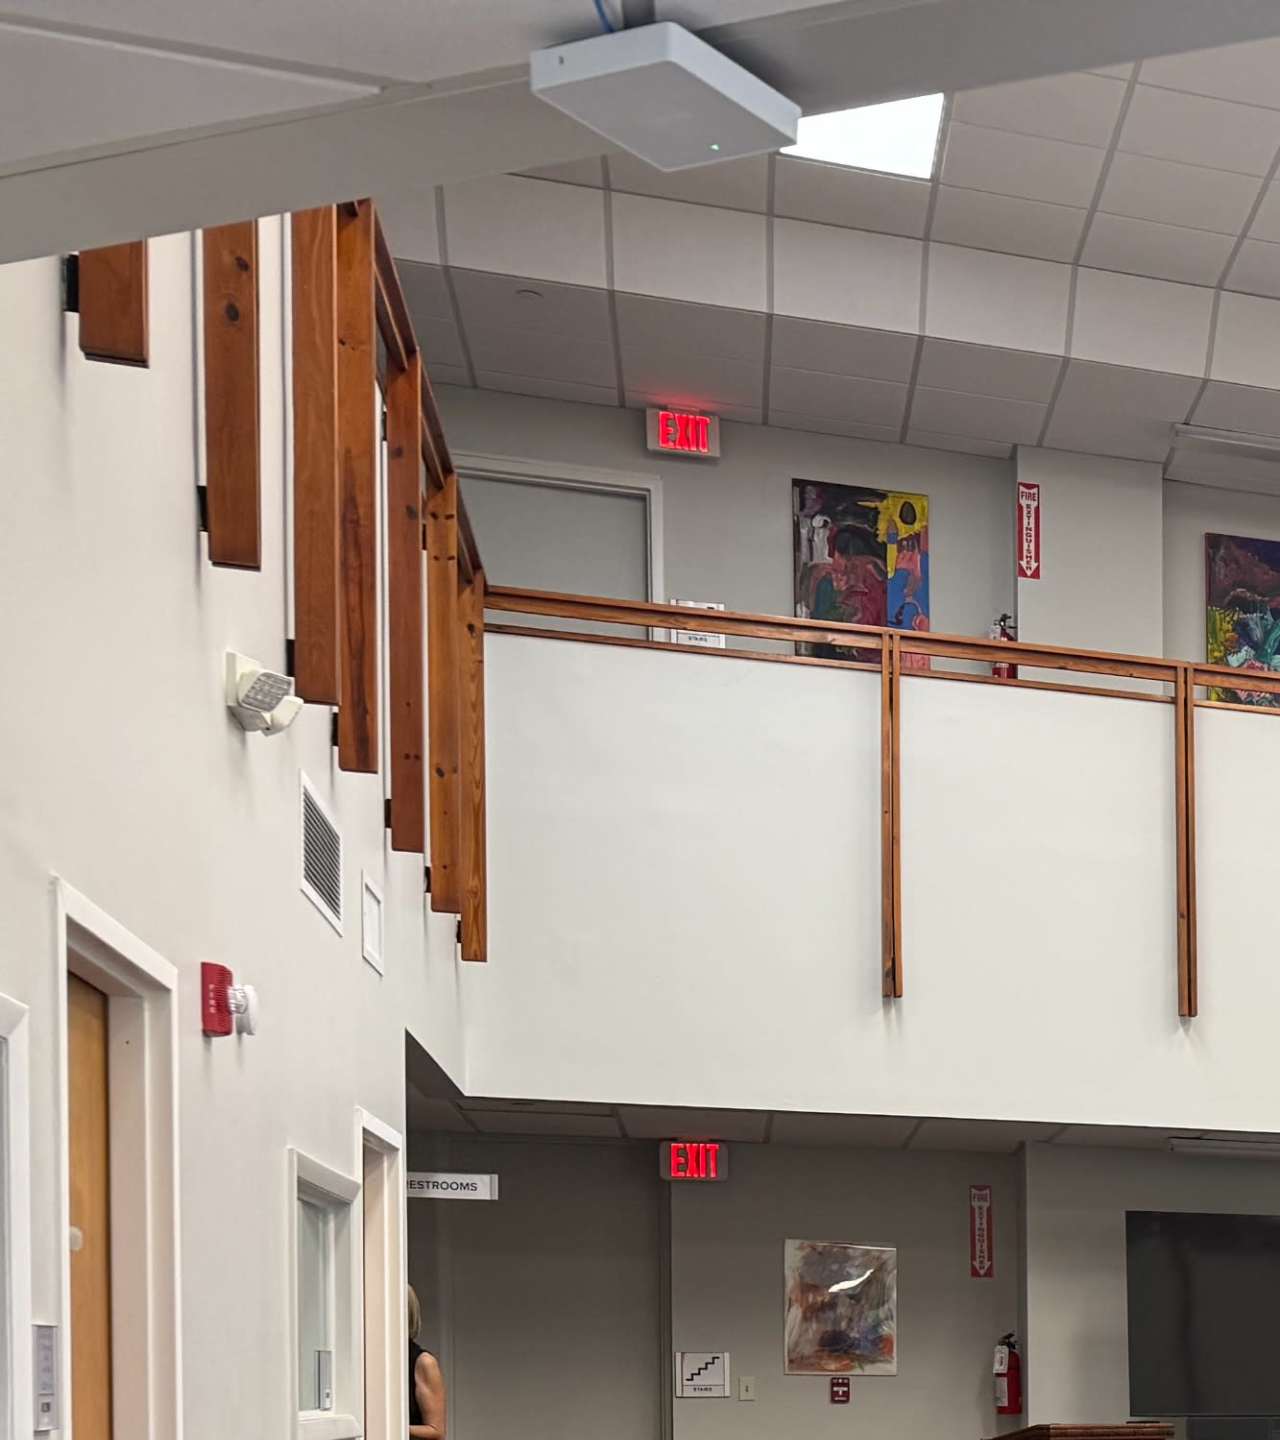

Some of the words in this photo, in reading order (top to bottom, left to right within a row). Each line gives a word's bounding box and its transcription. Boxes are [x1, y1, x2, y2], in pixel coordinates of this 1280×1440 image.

[658, 411, 711, 453] EXIT
[1020, 490, 1037, 502] FIRE
[1025, 503, 1033, 572] EXTINGUISHER
[670, 1143, 720, 1178] EXIT
[407, 1180, 478, 1192] ESTROOMS
